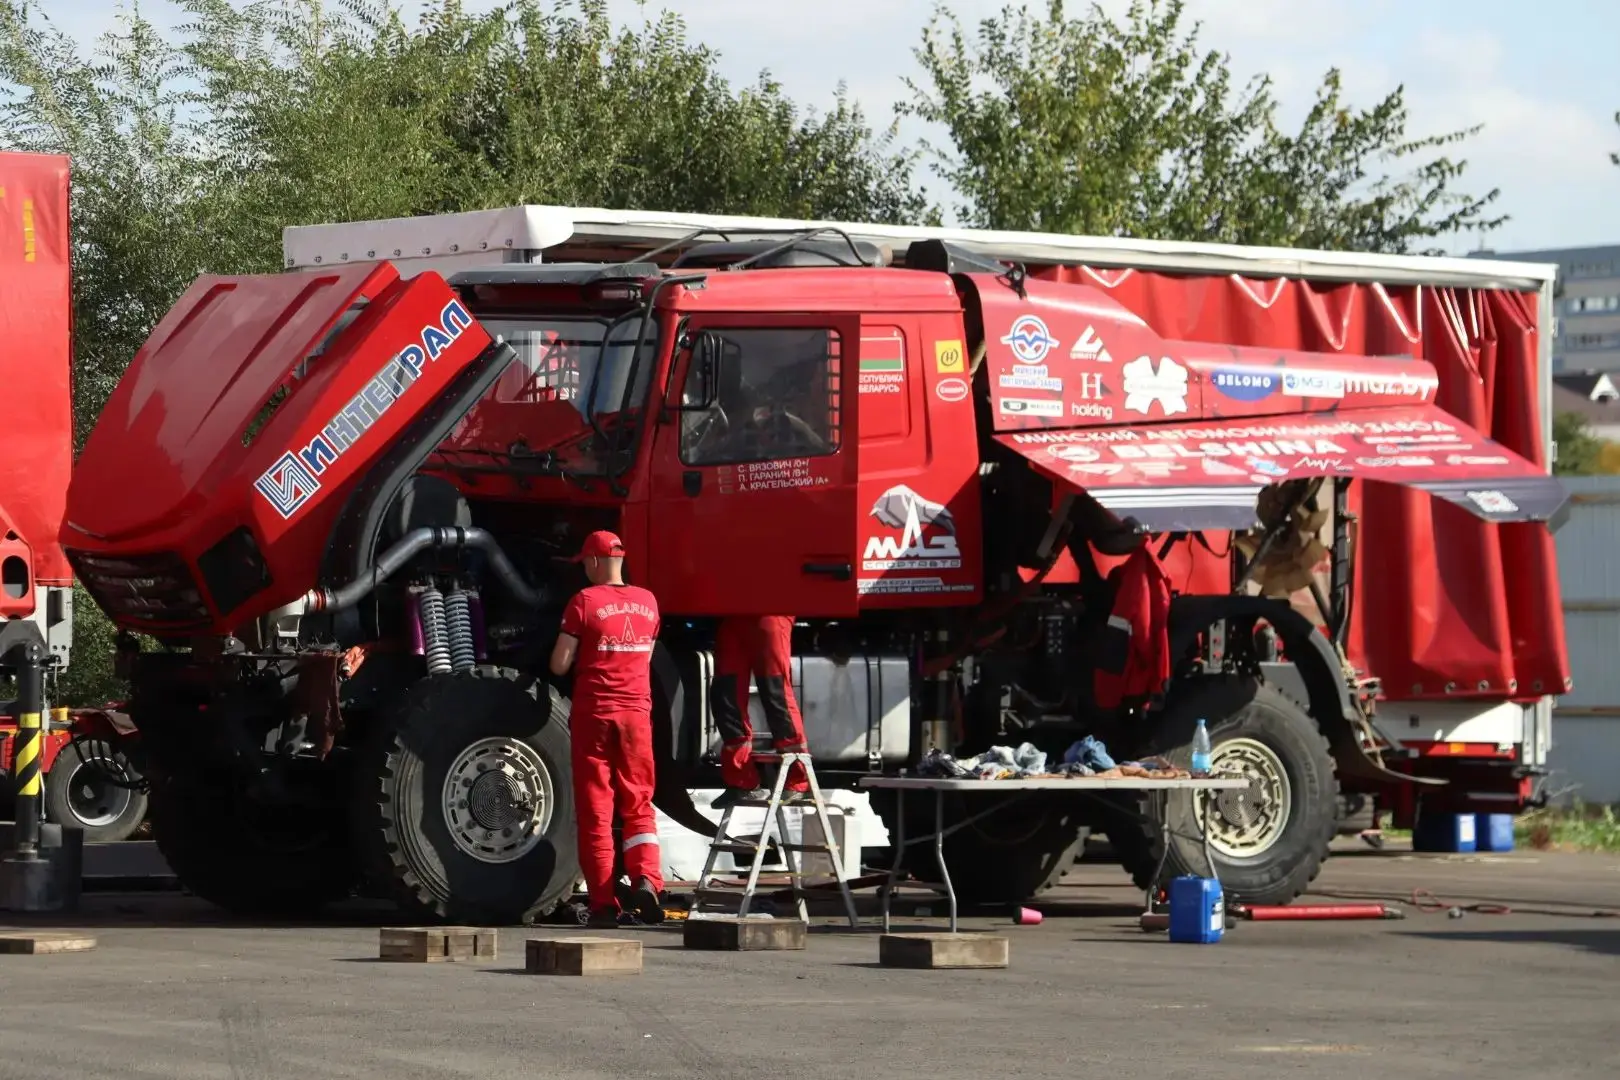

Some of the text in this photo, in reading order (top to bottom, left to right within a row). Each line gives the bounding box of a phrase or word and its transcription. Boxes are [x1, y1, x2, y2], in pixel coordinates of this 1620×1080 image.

[859, 374, 903, 383] ЕСПУБЛИКА
[1217, 374, 1272, 388] BELOMO
[299, 298, 473, 476] ИНТЕГРАЛ
[859, 384, 900, 393] БЕЛАРУСЬ
[1080, 372, 1104, 400] H
[1072, 403, 1112, 420] holding
[1110, 438, 1348, 459] BELSHINA
[749, 461, 792, 472] ВЯЗОВИЧ
[750, 470, 790, 481] ГАРАНИН
[750, 476, 813, 490] КРАГЕЛЬСКИЙ
